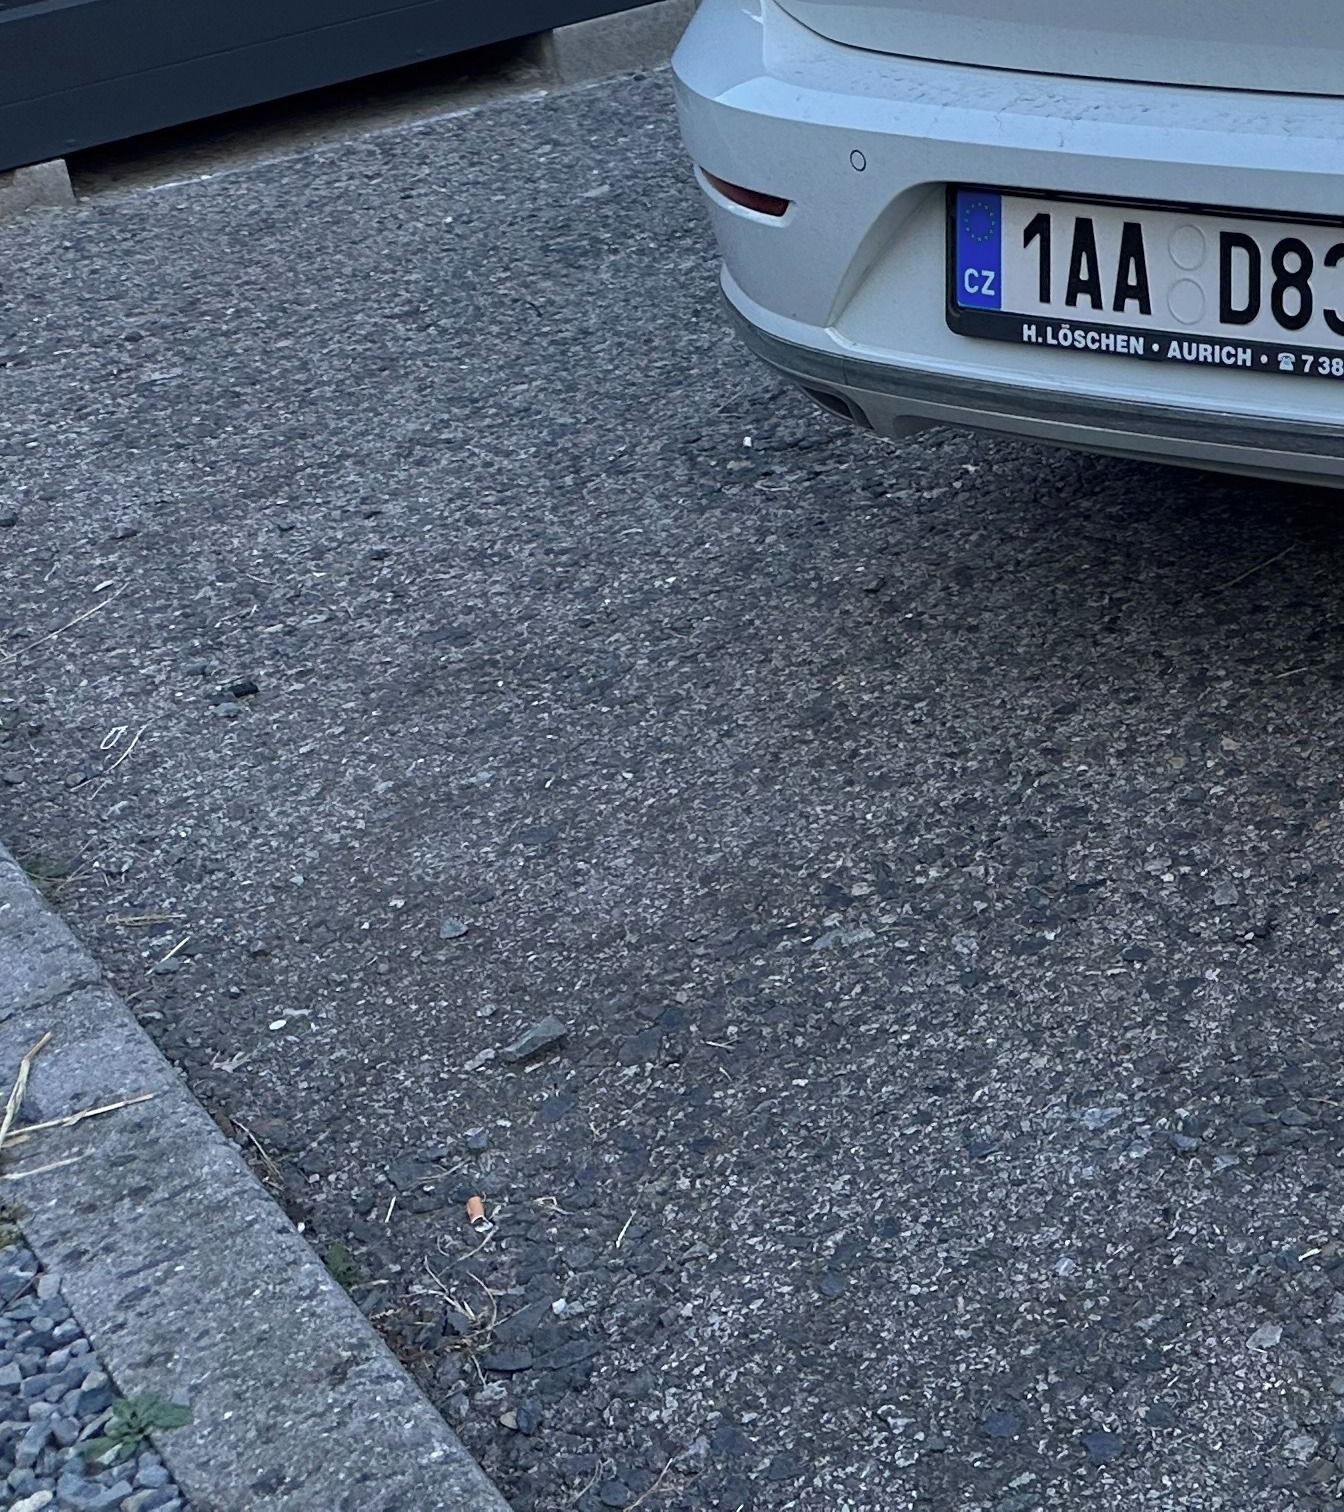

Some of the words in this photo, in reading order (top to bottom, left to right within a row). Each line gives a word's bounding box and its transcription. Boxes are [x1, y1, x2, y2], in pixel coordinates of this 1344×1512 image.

[963, 268, 996, 297] CZ
[1022, 212, 1152, 318] 1AA
[1167, 340, 1253, 367] AURICH
